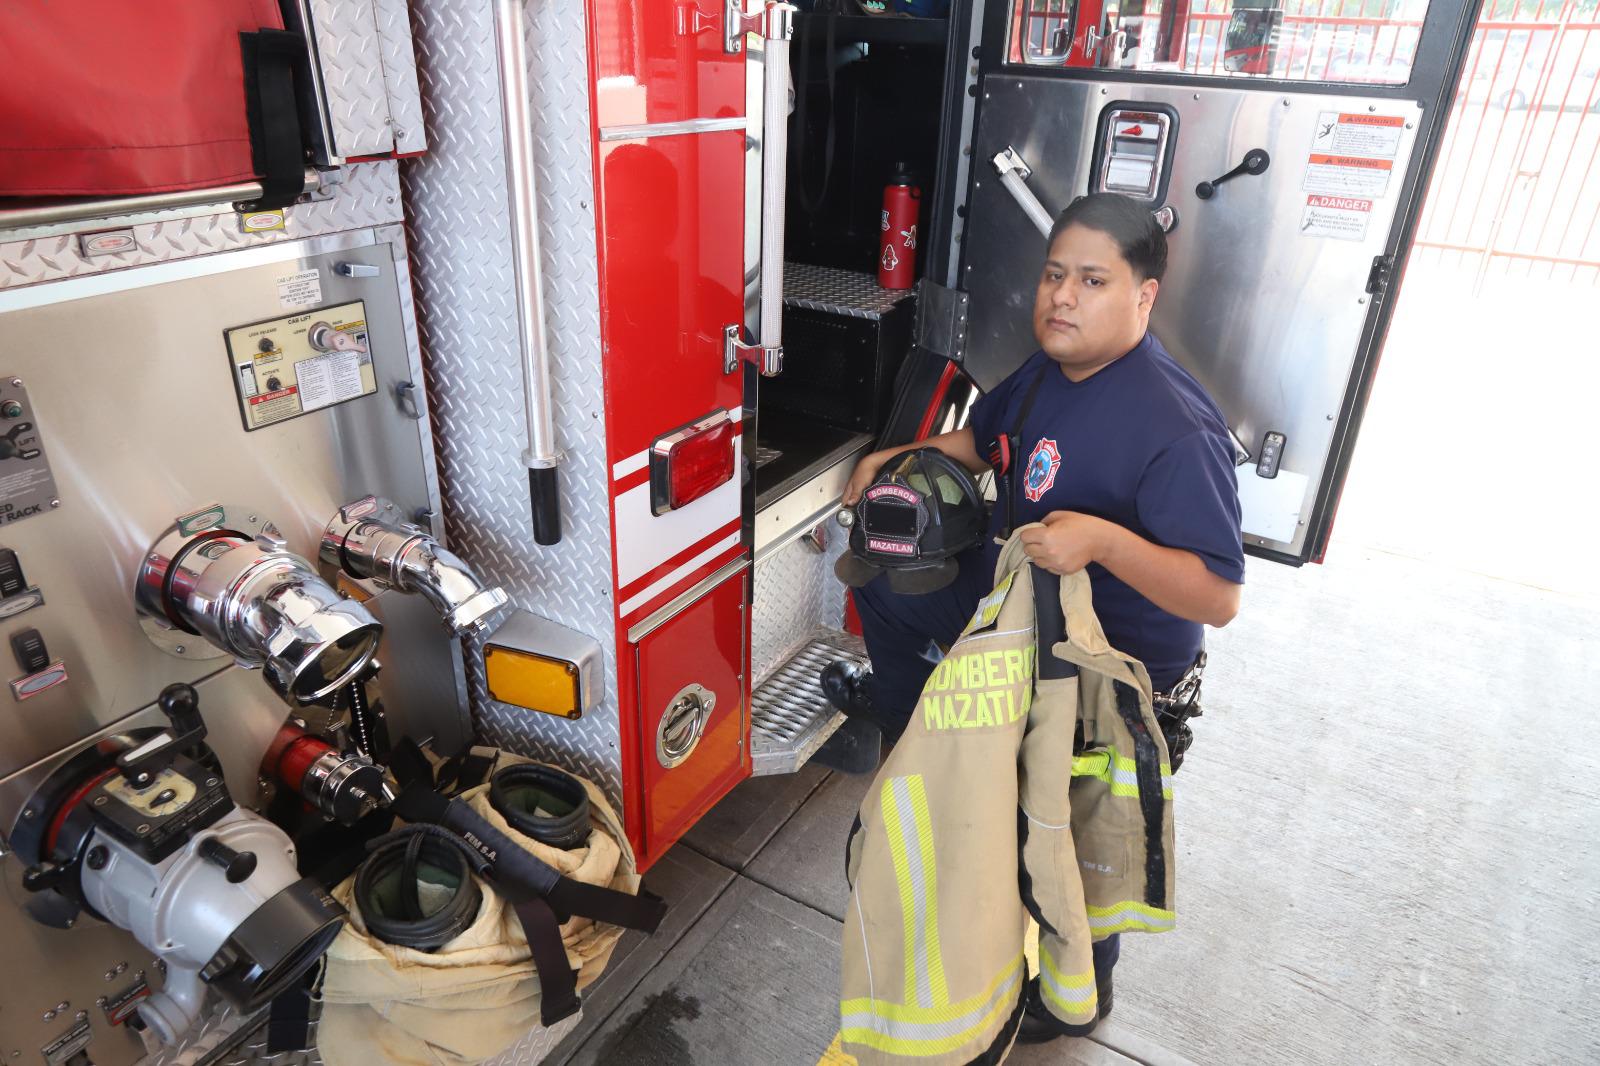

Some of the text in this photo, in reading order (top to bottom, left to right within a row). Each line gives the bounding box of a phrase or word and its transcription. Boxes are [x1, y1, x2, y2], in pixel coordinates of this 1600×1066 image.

[1337, 158, 1379, 168] WARNING
[1320, 197, 1370, 210] DANGER
[287, 315, 312, 325] CAB LIFT
[266, 390, 290, 400] DANGER
[18, 436, 36, 446] LIFT
[871, 487, 915, 502] BOMBEROS
[6, 503, 42, 521] RACK
[870, 540, 914, 553] MAZATLAN
[464, 831, 497, 862] FEM S.A.
